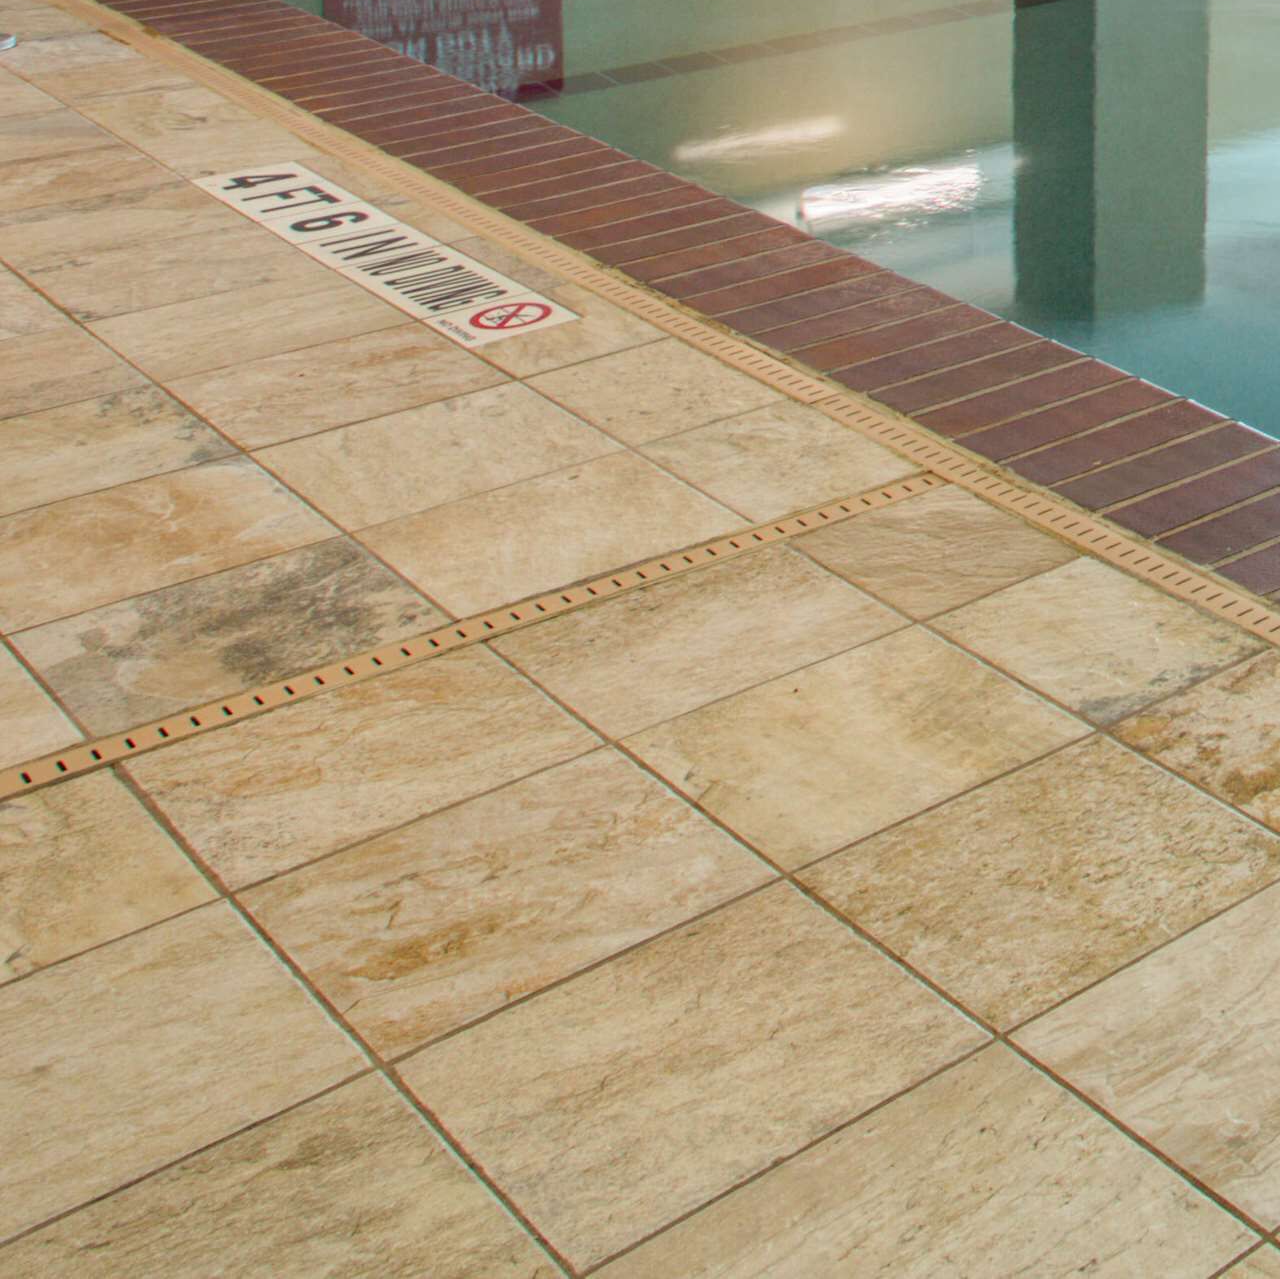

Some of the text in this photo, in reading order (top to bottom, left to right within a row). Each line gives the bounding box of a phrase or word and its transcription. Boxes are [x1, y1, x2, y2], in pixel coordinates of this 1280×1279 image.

[222, 173, 509, 312] 4 FT 6 IN NO DIVING
